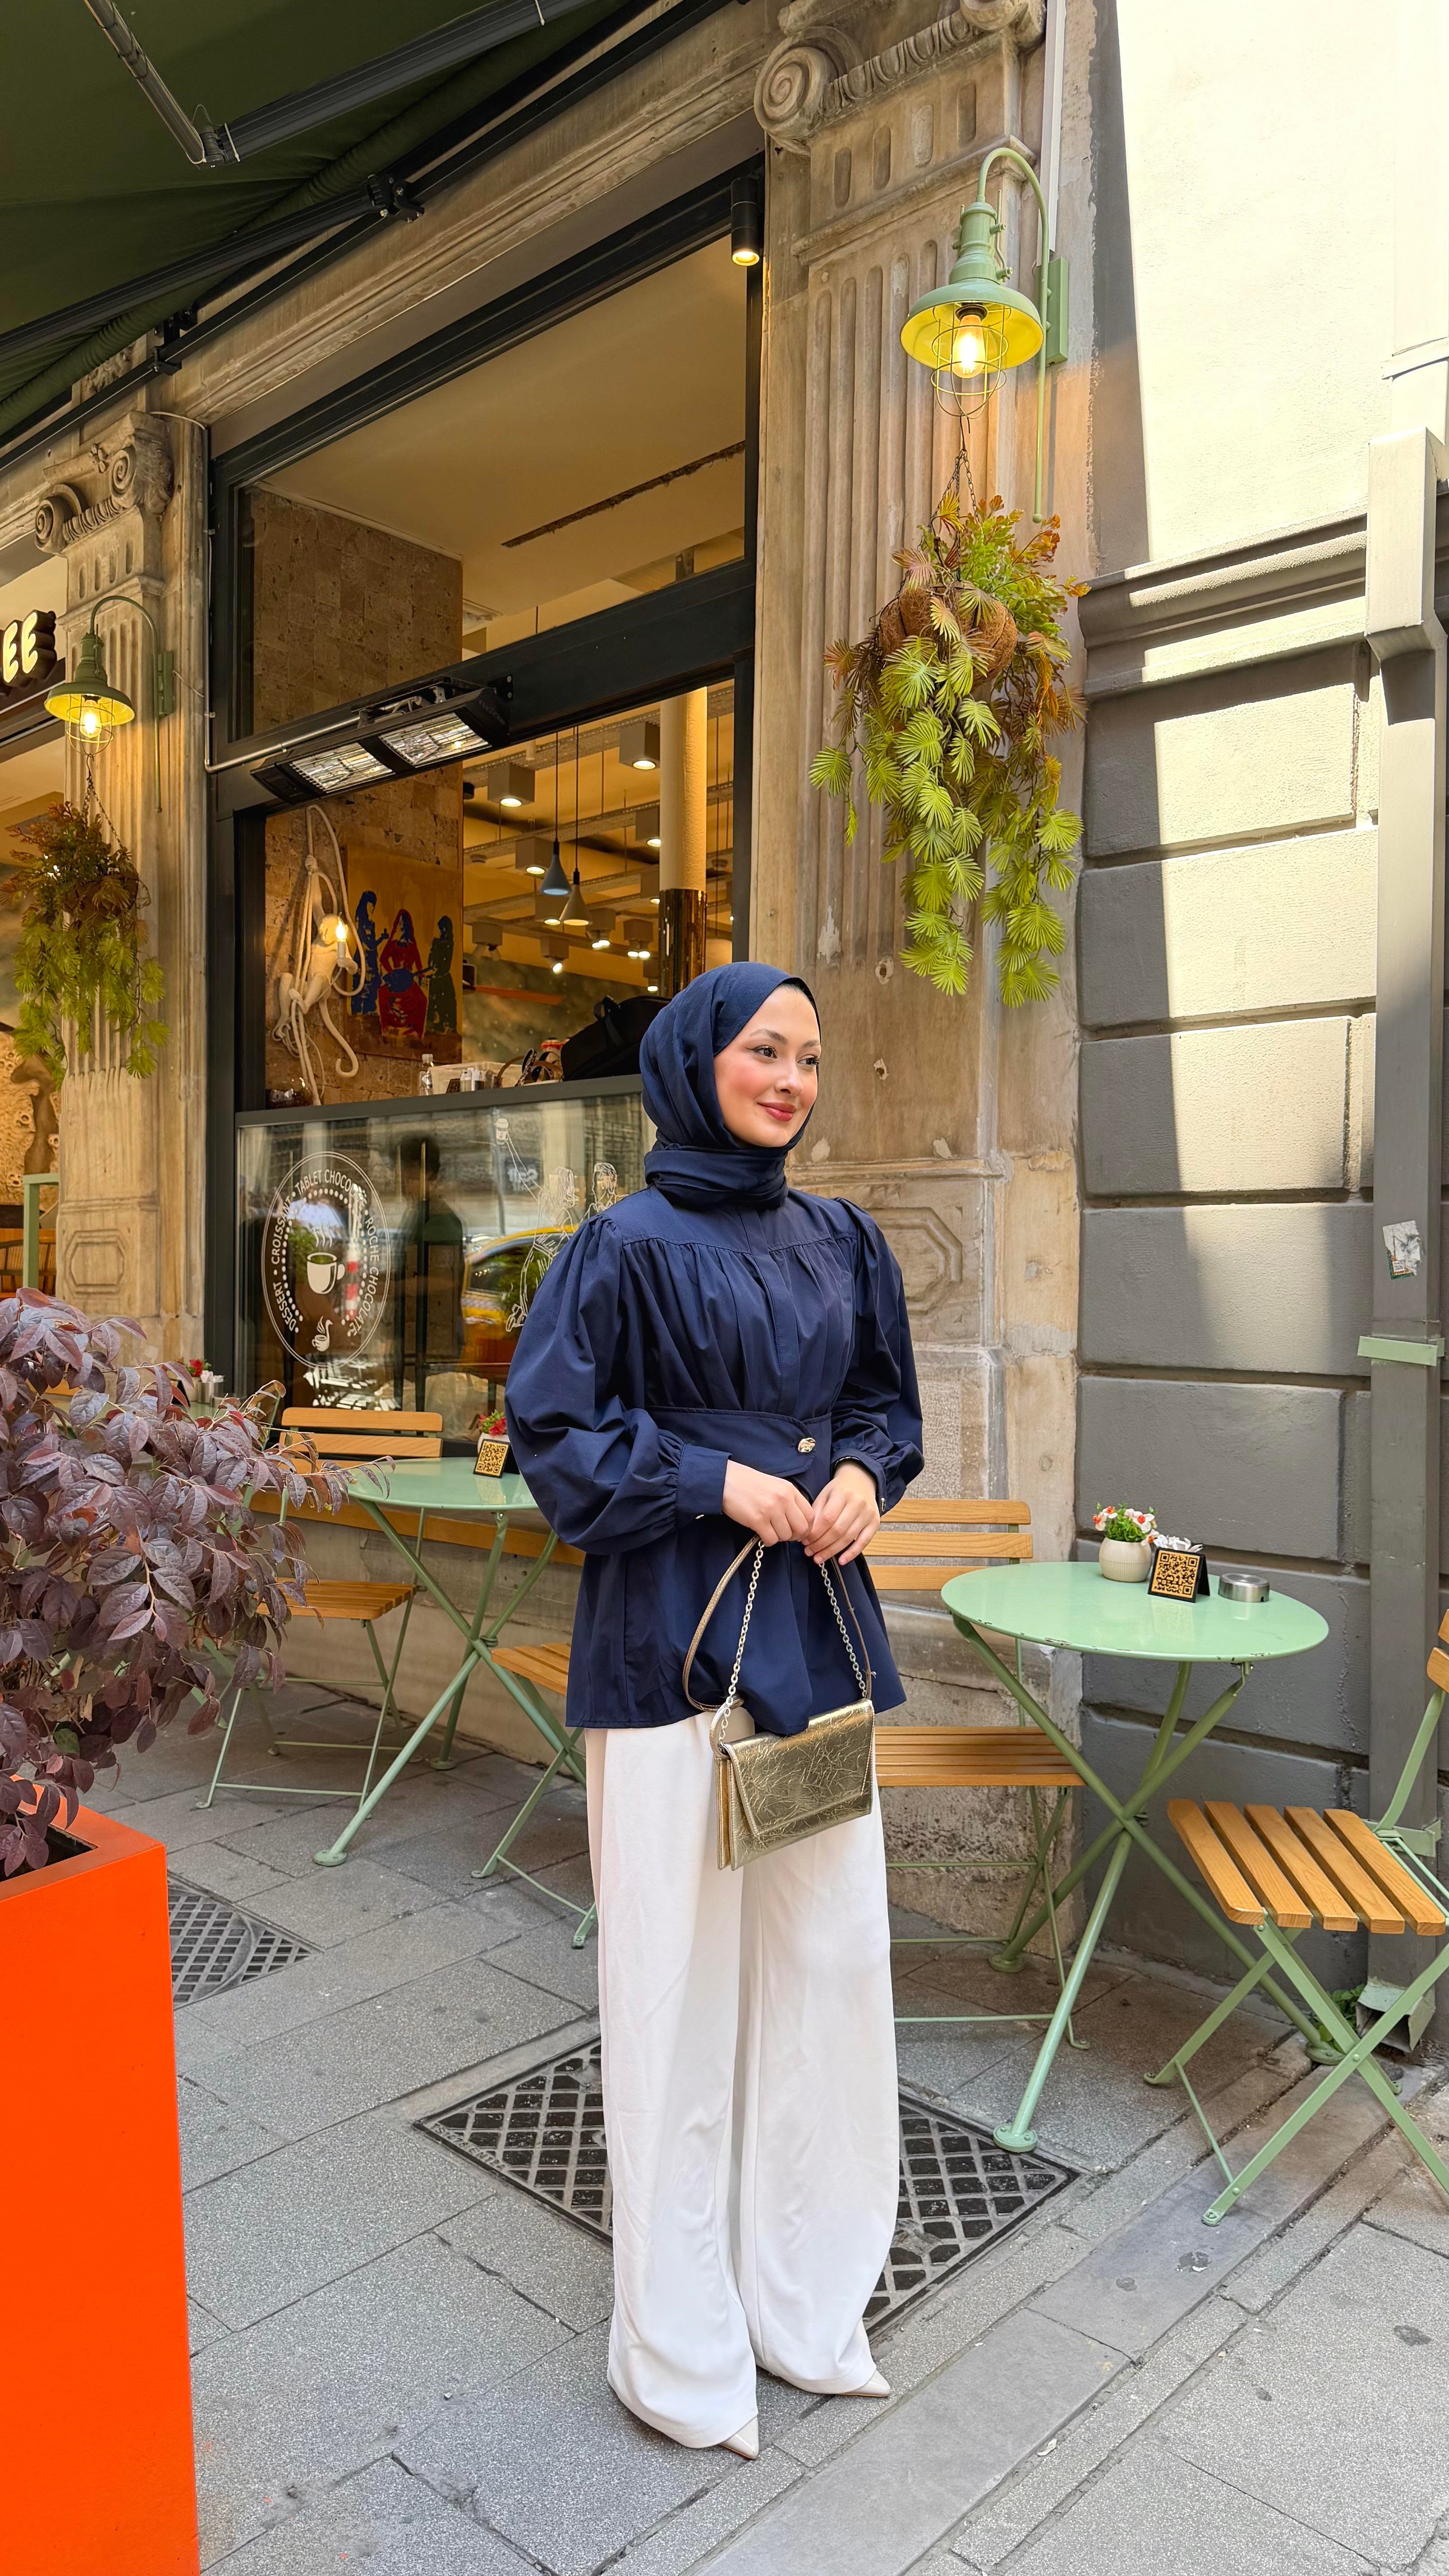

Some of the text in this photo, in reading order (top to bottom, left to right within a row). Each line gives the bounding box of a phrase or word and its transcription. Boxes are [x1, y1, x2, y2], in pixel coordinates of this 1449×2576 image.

[294, 1170, 322, 1195] TABLET
[271, 1196, 291, 1265] CROISSANT
[365, 1216, 380, 1262] ROCHE
[272, 1282, 297, 1331] DESSERT
[349, 1267, 379, 1336] CHOCOLATE
